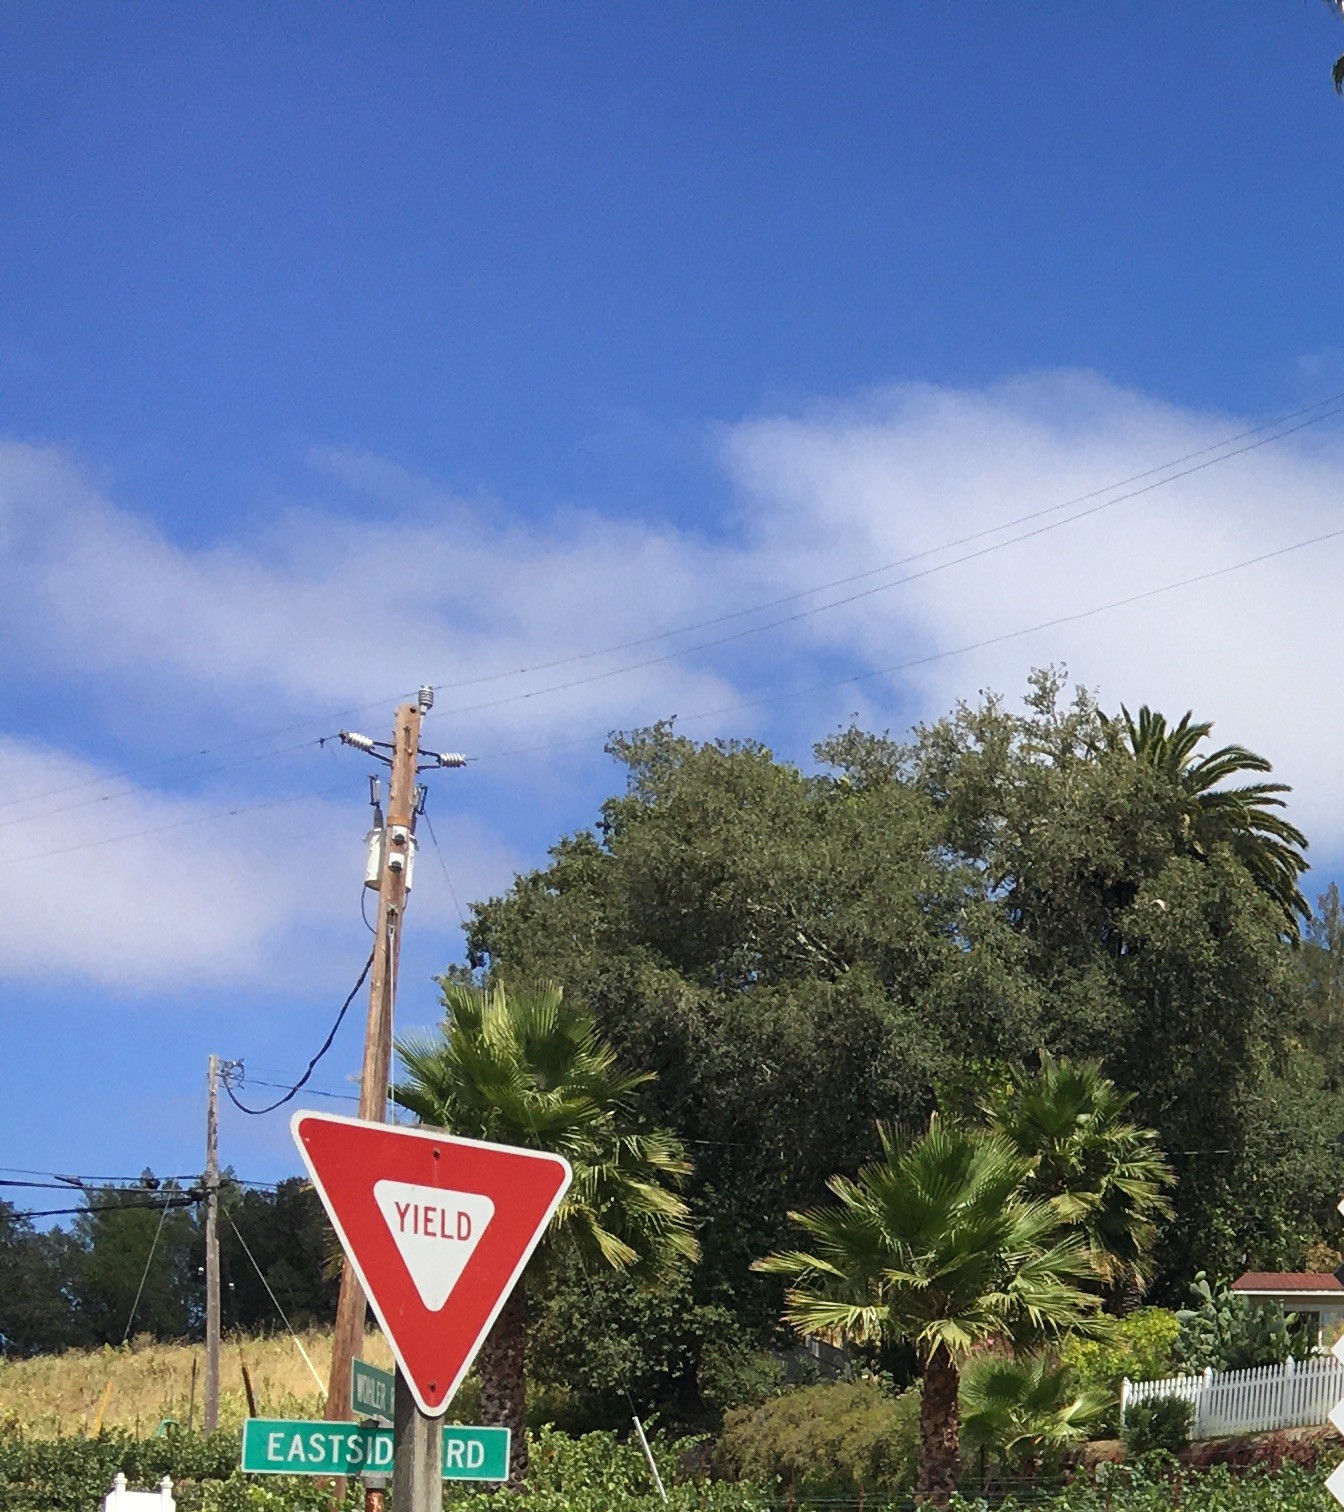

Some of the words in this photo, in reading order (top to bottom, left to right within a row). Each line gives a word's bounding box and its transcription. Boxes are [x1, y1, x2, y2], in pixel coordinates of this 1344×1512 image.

[395, 1201, 472, 1242] YIELD
[267, 1432, 393, 1466] EASTSID
[447, 1440, 485, 1469] RD
